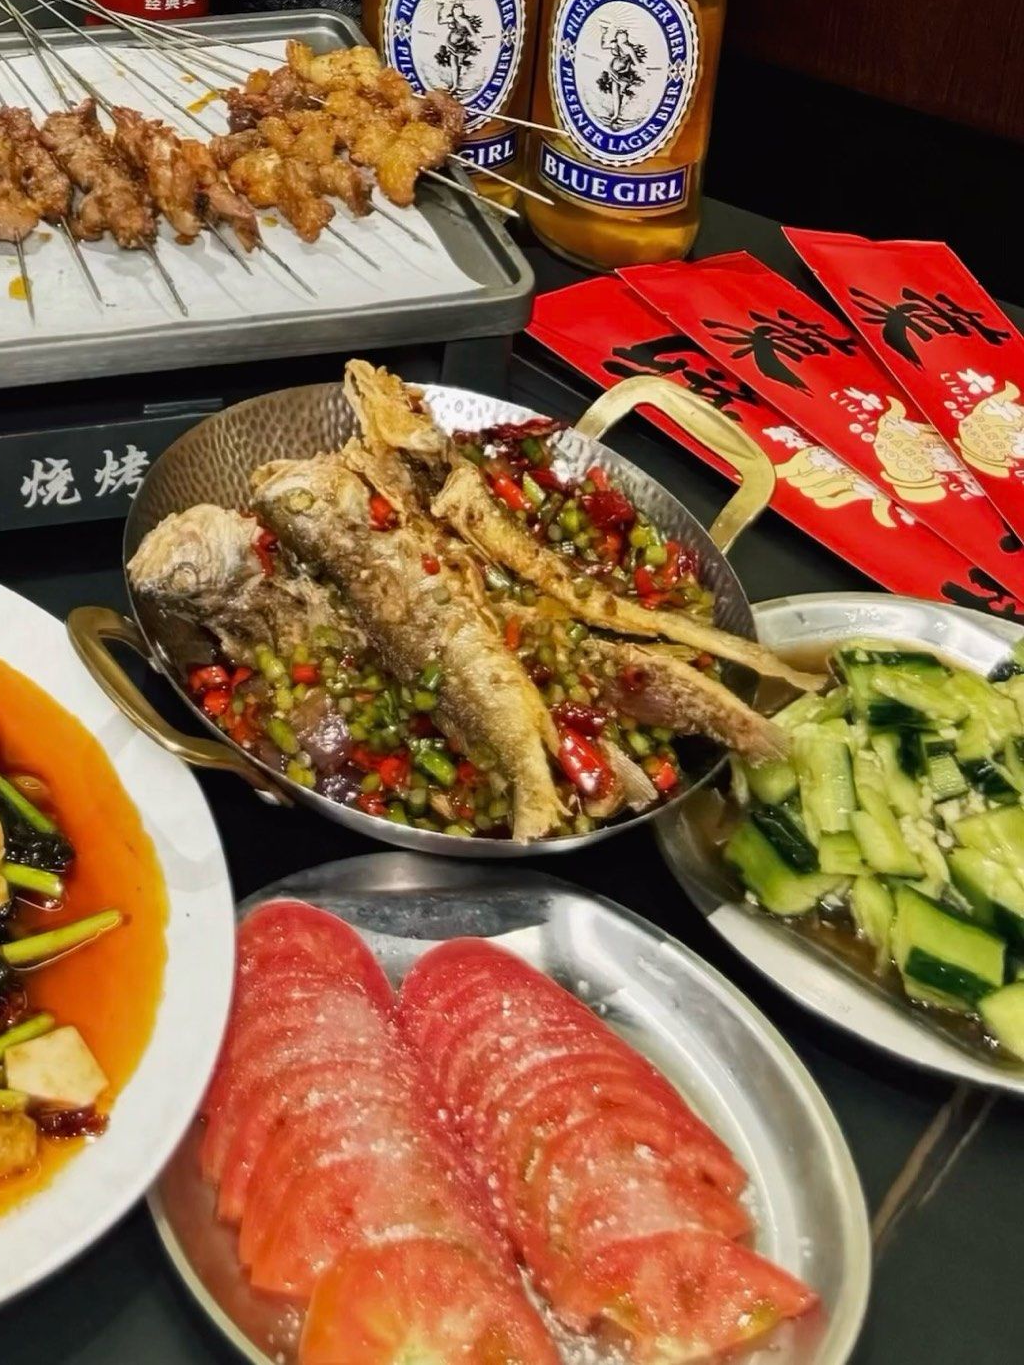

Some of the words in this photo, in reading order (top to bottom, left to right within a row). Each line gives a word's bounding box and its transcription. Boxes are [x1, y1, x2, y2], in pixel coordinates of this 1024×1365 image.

[666, 21, 685, 57] BIER
[490, 50, 513, 86] BIER
[562, 66, 604, 147] PILSENER
[608, 121, 663, 152] LAGER
[656, 84, 681, 123] BIER
[544, 153, 608, 199] BLUE
[613, 179, 682, 204] GIRL
[829, 392, 877, 426] LIUZI
